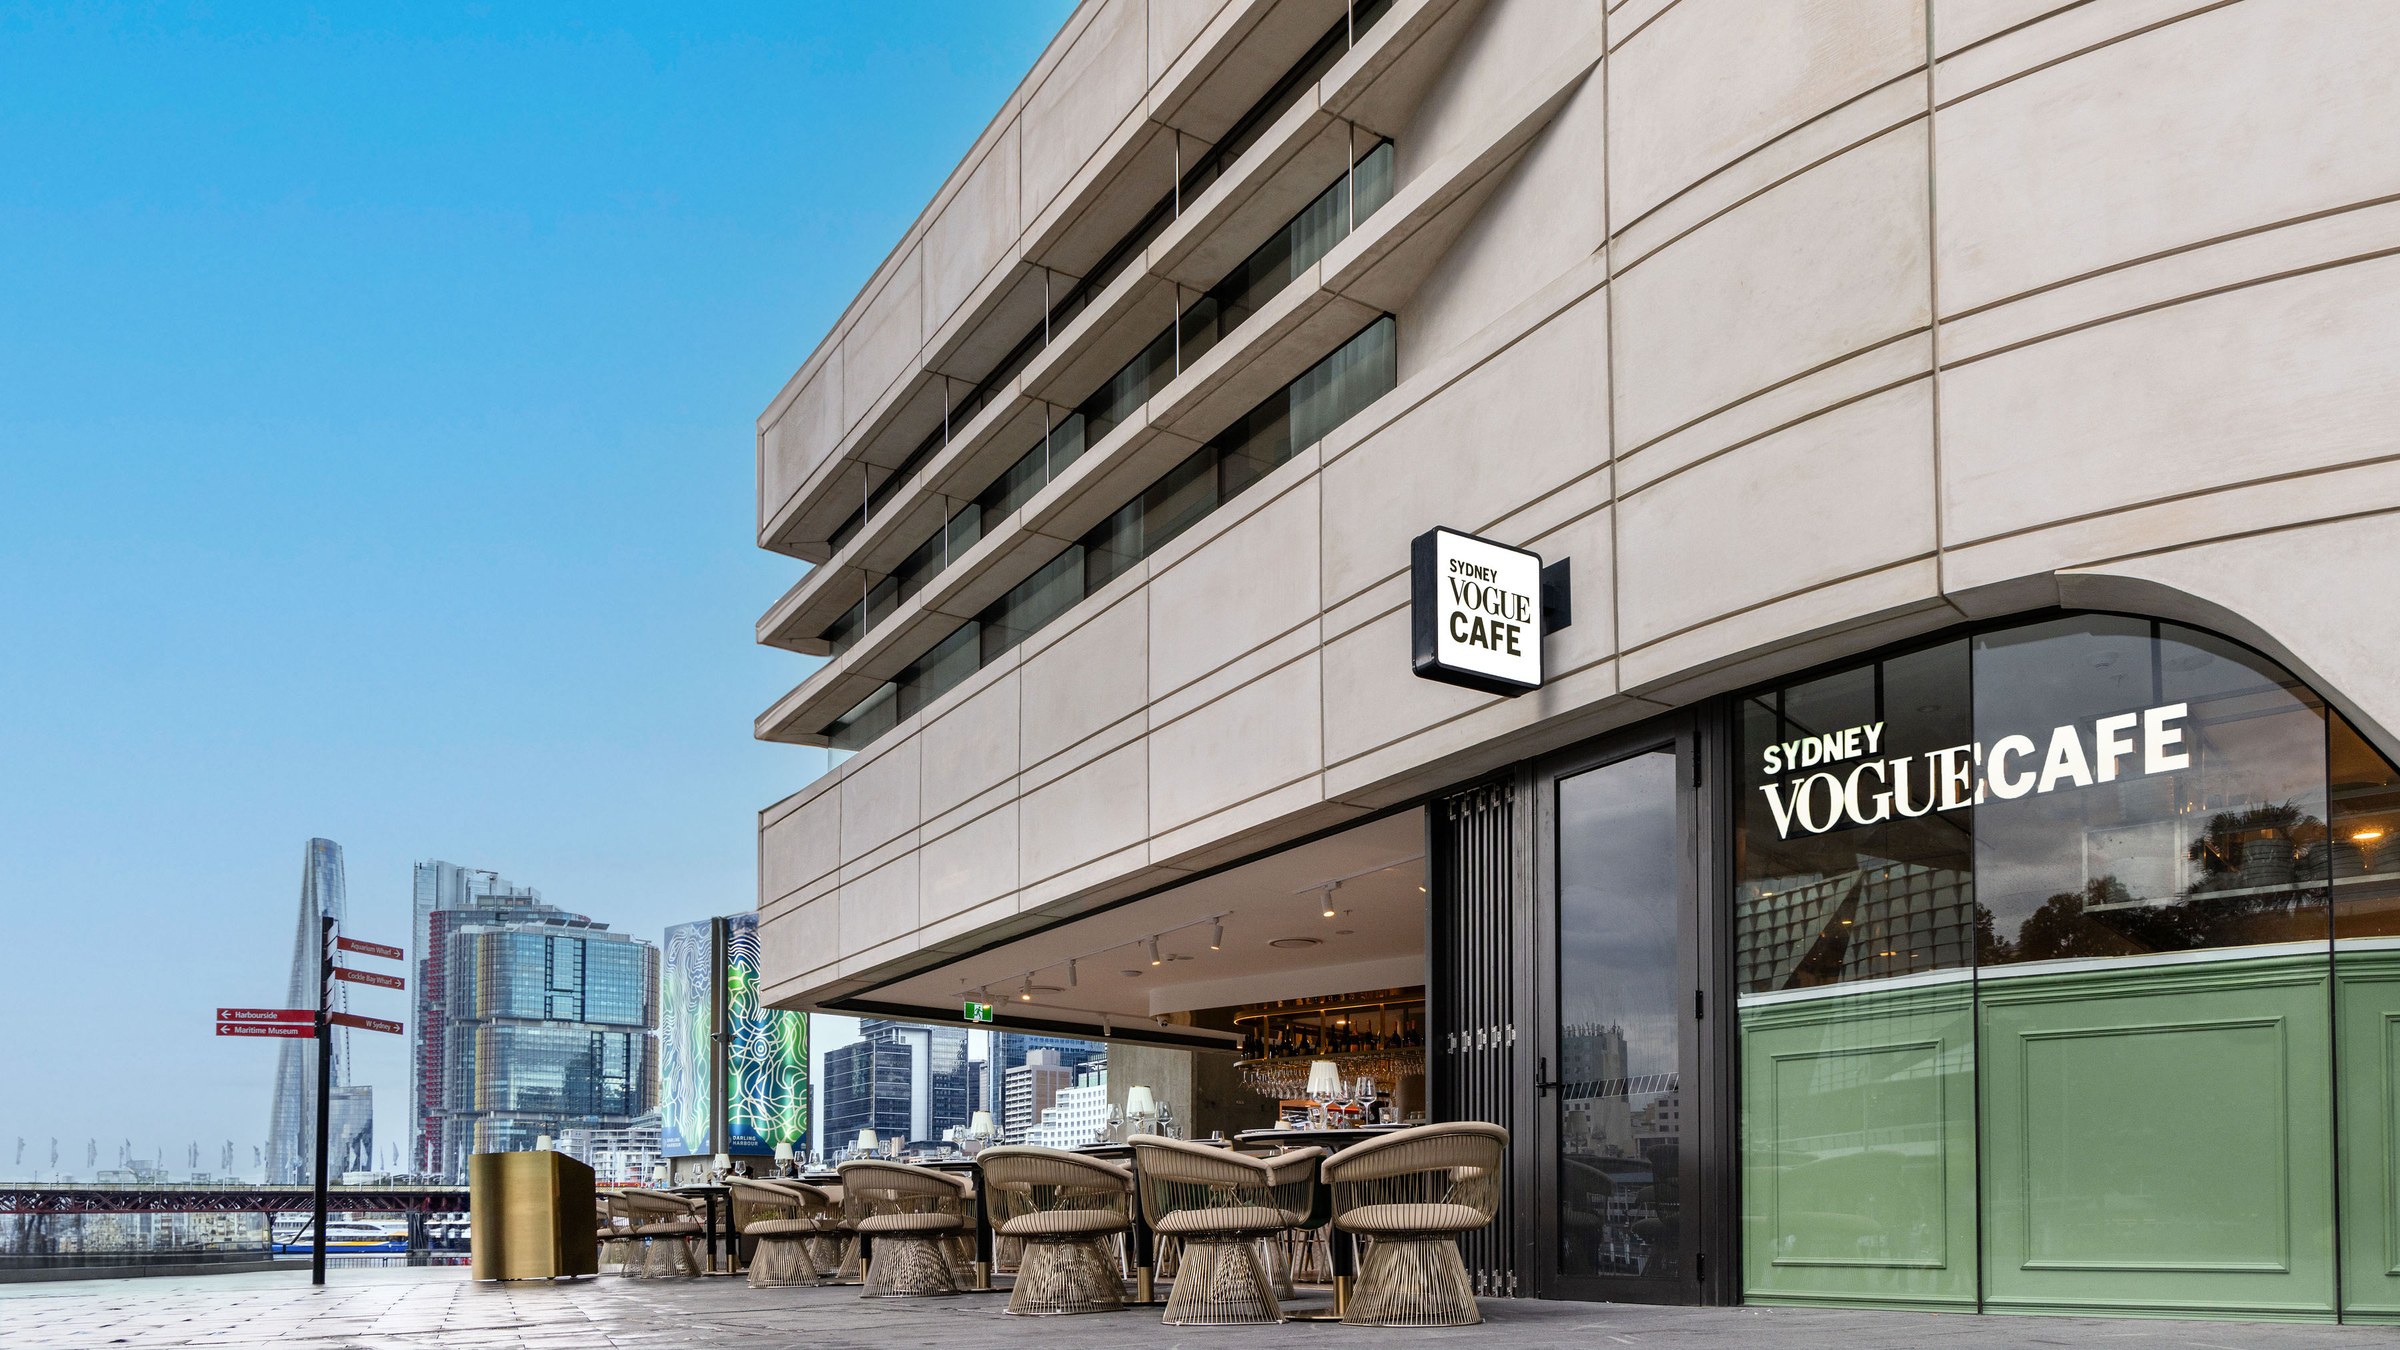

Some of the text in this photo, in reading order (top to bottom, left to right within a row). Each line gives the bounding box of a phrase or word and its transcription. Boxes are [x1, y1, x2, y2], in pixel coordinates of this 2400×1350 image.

[1449, 558, 1498, 583] SYDNEY
[1448, 575, 1531, 624] VOGUE
[1450, 610, 1521, 657] CAFE
[1762, 721, 1886, 775] SYDNEY
[1759, 702, 2190, 840] VOGUE CAFE
[351, 942, 392, 955] Aquarium Wharf
[347, 971, 393, 985] Cockle Bay Wharf
[235, 1011, 278, 1019] Harbourside
[234, 1026, 299, 1035] Maritime Museum
[365, 1019, 392, 1031] W Sydney
